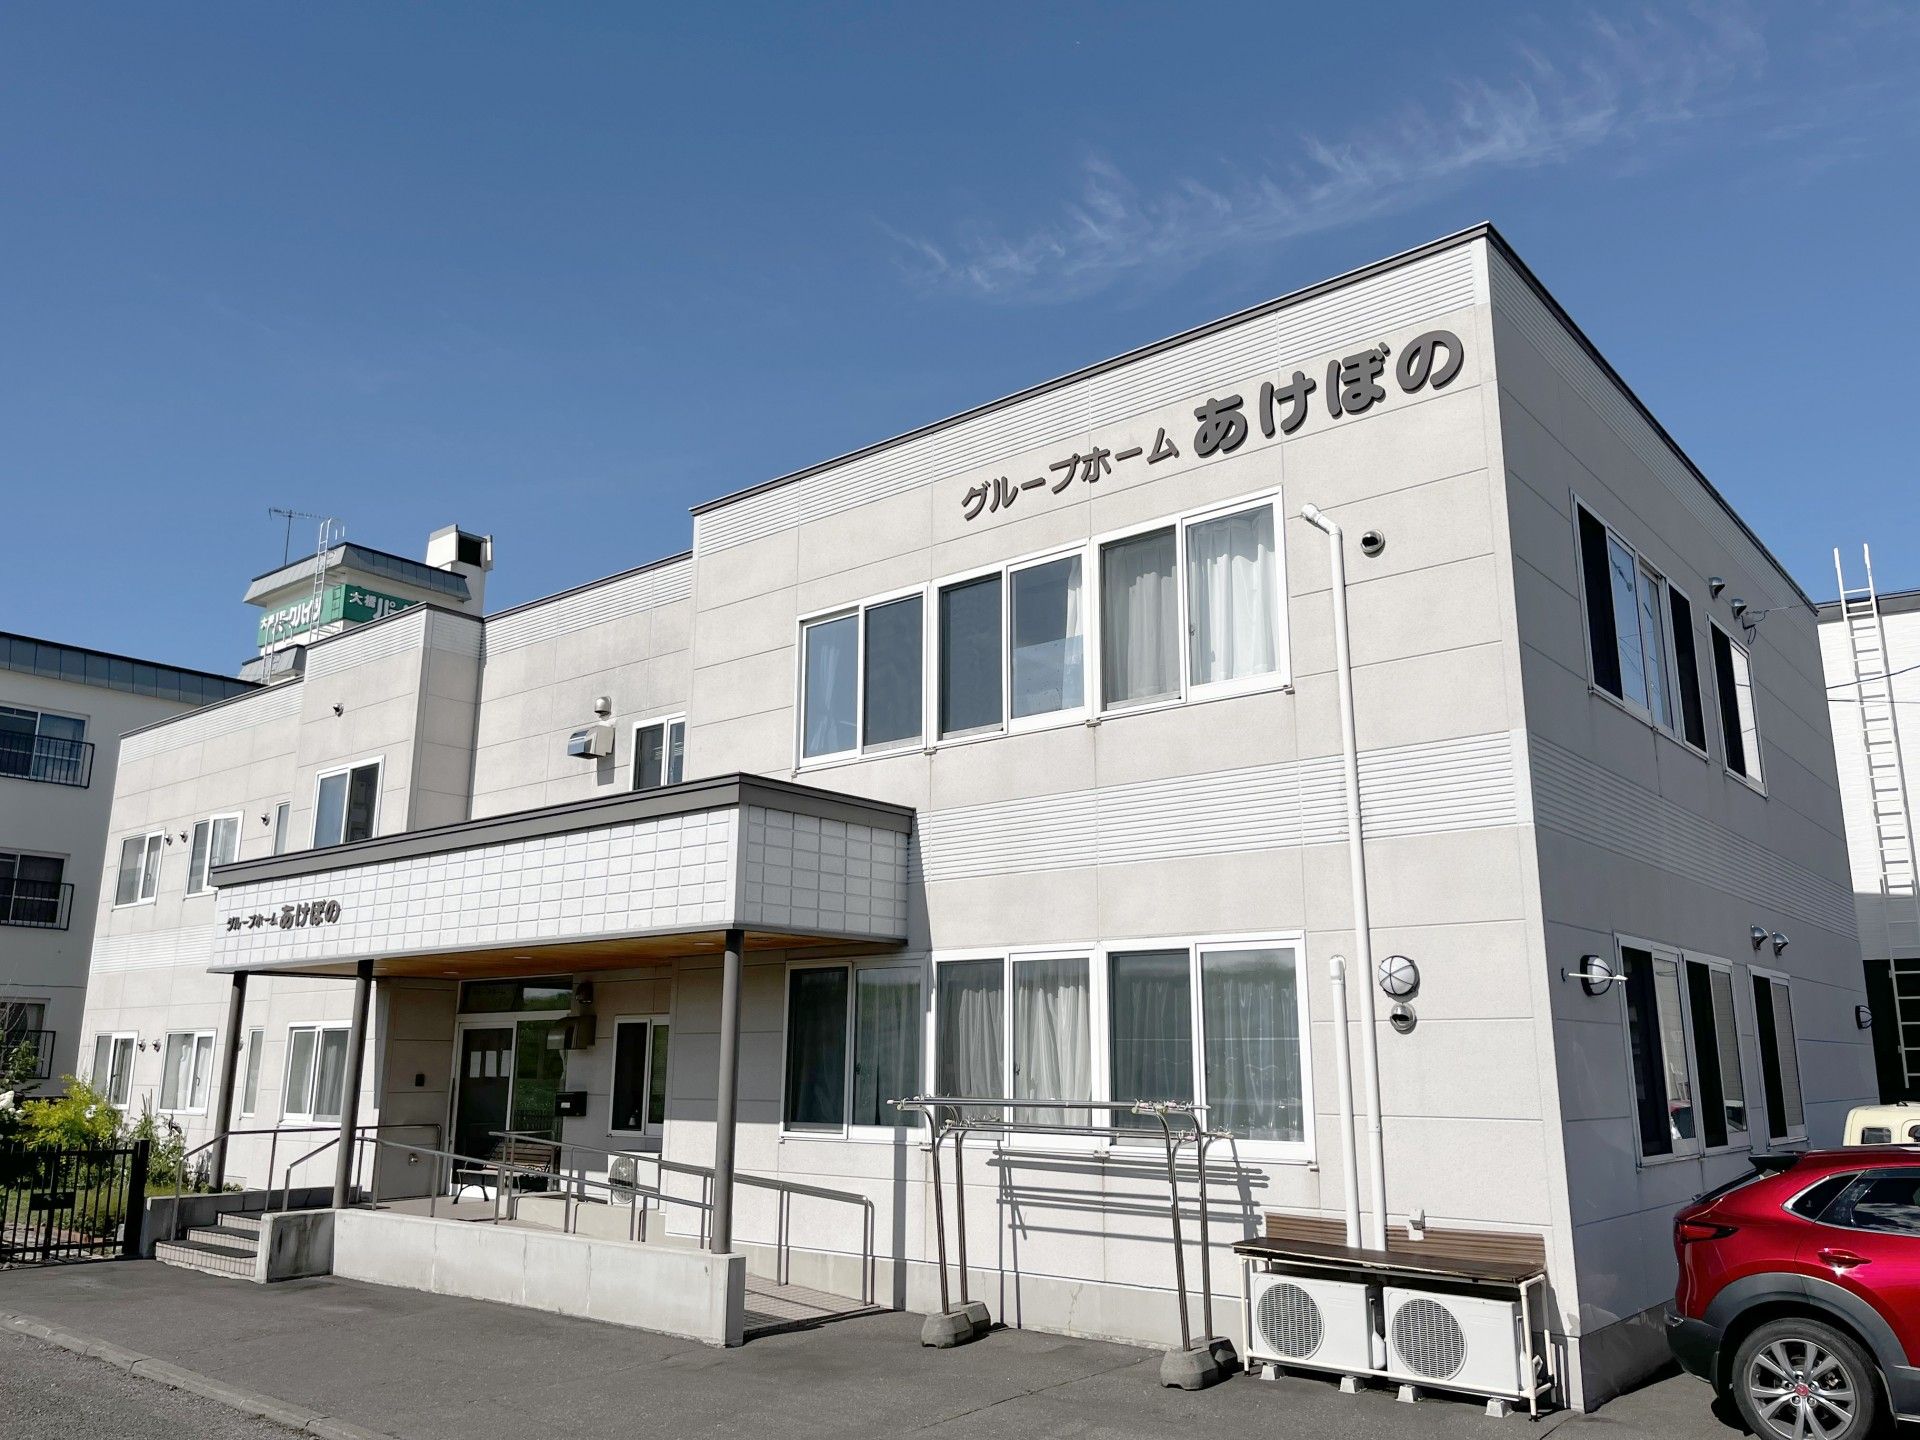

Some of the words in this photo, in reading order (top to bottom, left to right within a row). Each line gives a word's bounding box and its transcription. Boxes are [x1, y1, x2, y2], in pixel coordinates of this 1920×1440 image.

[961, 427, 1180, 521] グループホーム
[1193, 329, 1465, 458] あけぼの
[279, 899, 341, 930] あけぼの
